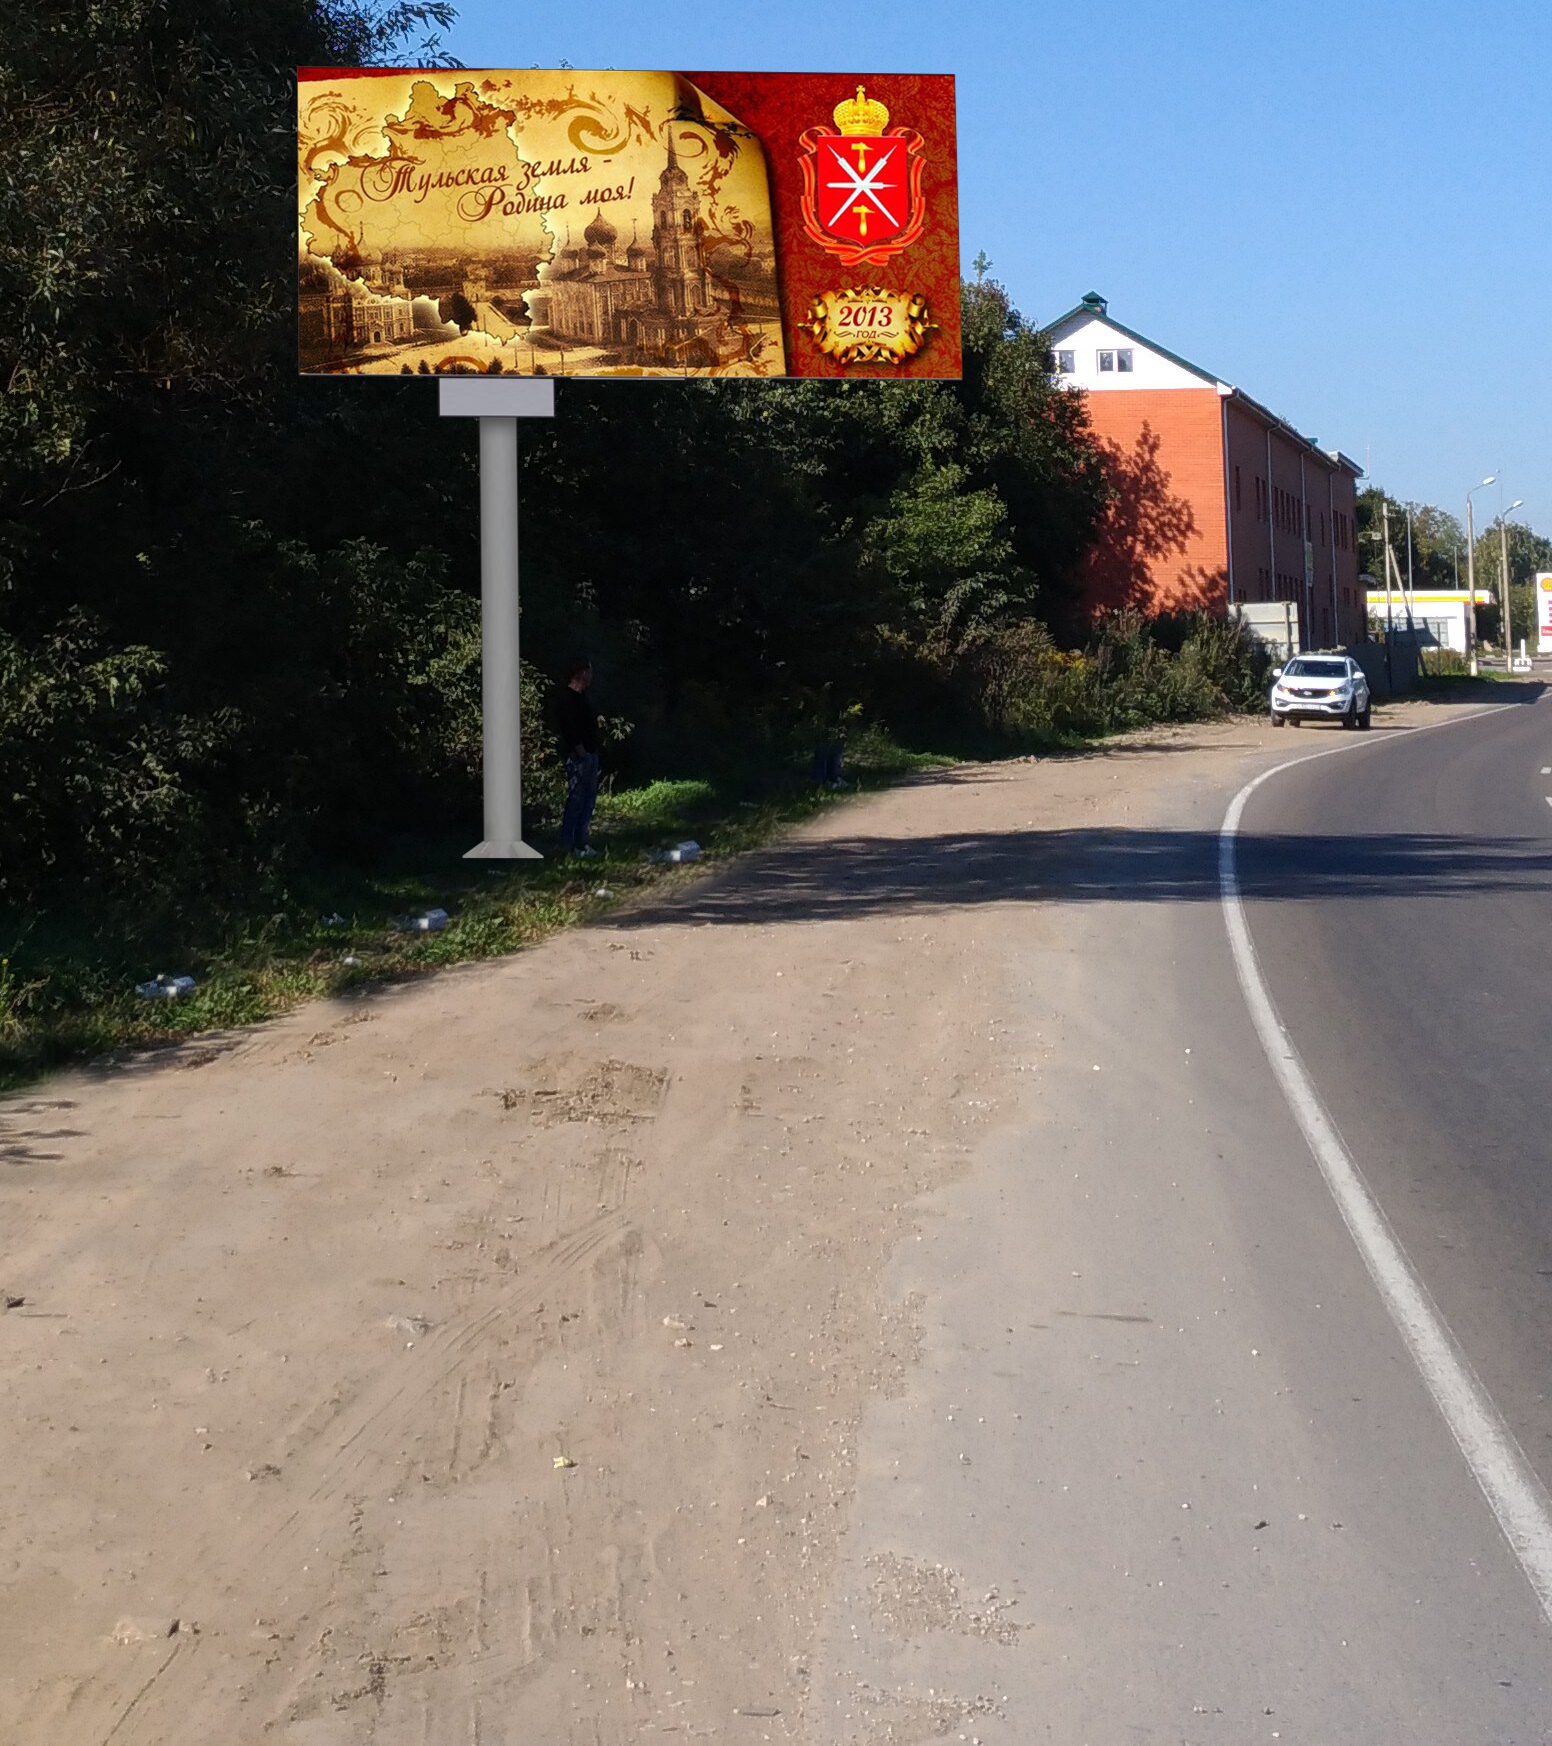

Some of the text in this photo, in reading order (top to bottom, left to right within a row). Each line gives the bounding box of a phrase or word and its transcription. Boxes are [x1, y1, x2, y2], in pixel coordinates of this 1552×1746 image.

[360, 157, 509, 203] Тульская
[516, 156, 591, 191] земля
[457, 176, 635, 222] Родина моя!
[838, 305, 893, 327] 2013
